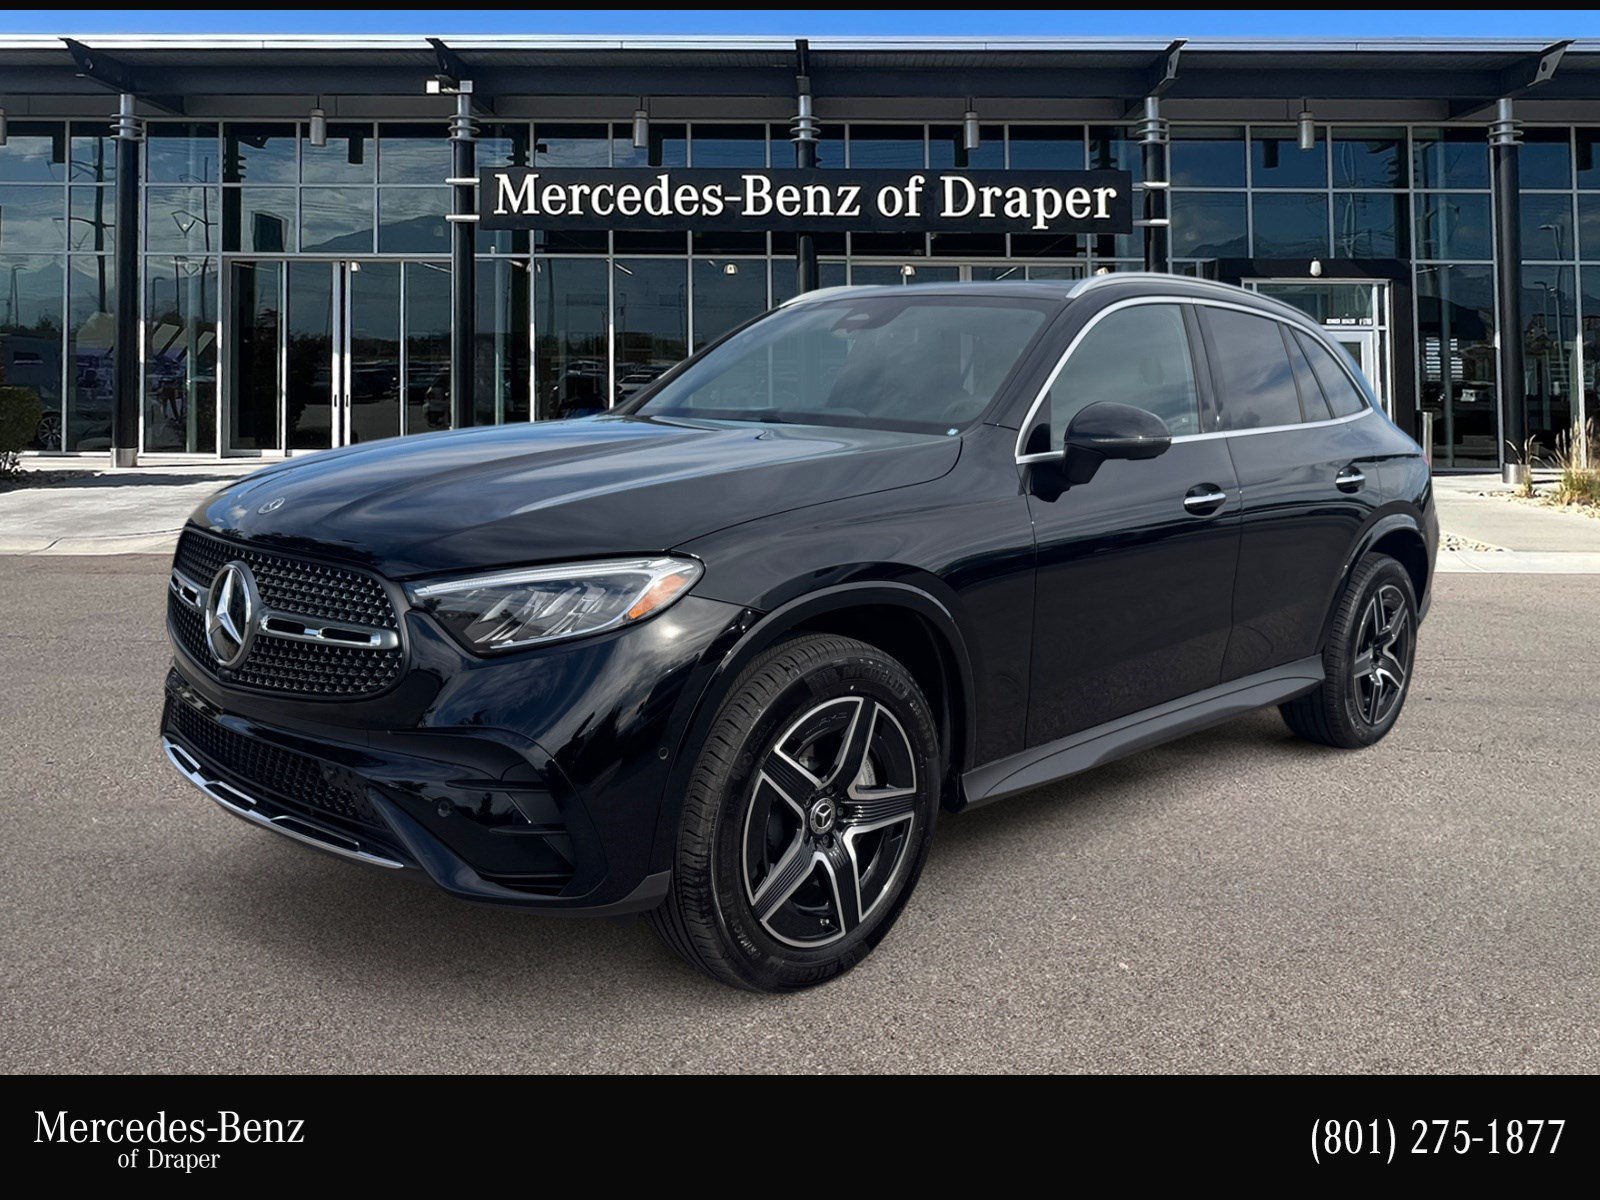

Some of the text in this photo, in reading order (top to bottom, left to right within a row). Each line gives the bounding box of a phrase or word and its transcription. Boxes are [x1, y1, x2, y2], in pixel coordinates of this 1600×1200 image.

[493, 172, 1118, 231] Mercedes-Benz of Draper
[729, 917, 761, 961] PRIMACY
